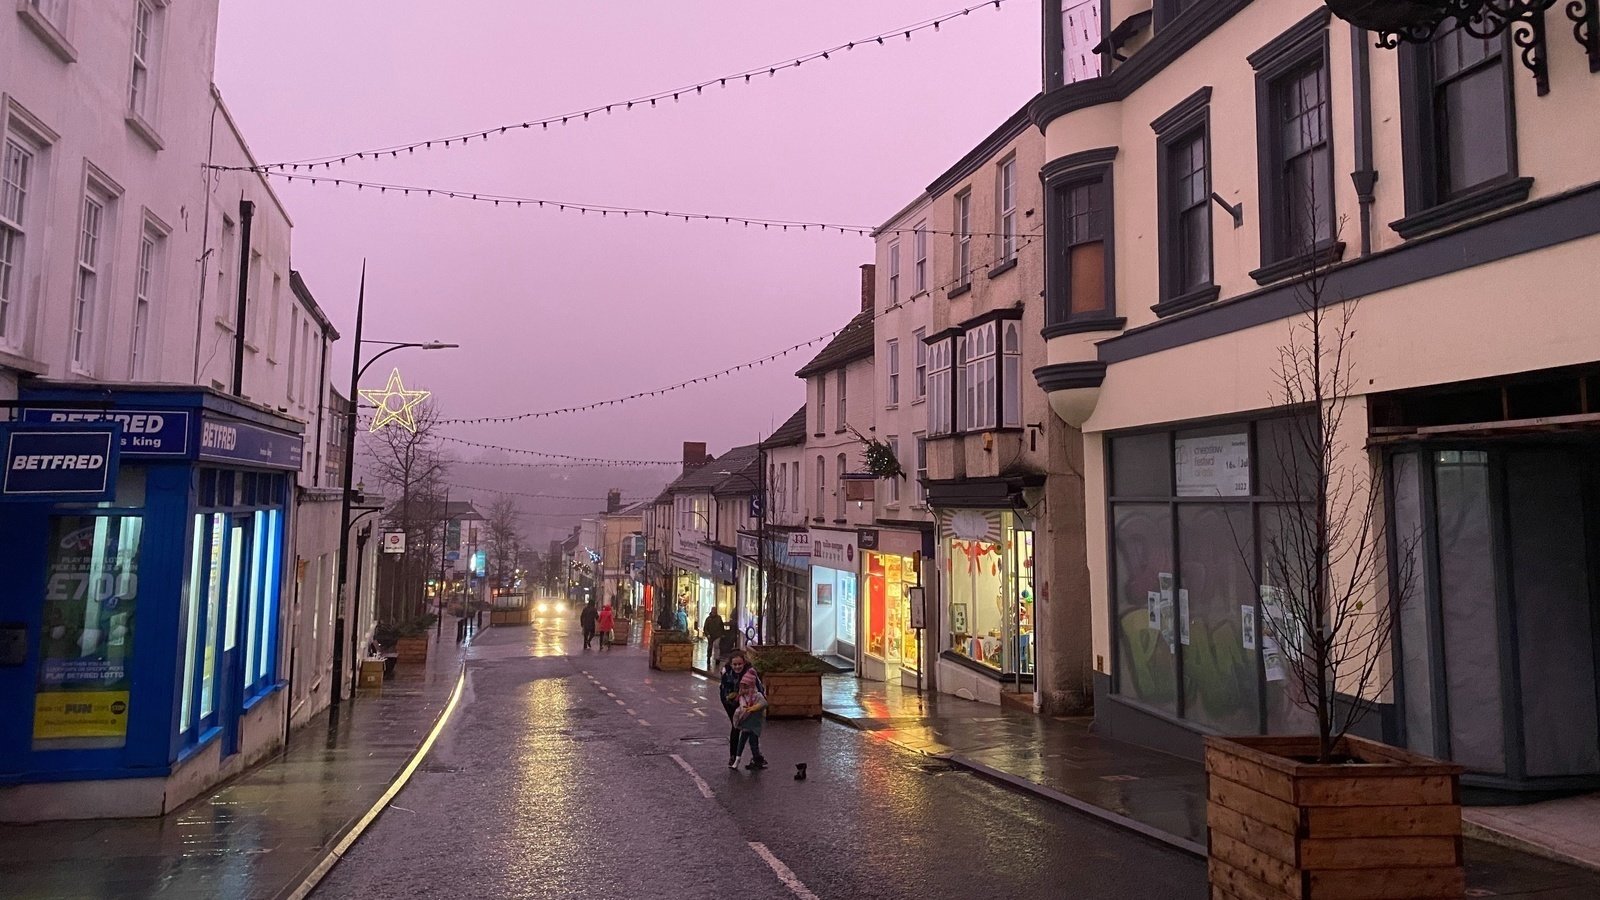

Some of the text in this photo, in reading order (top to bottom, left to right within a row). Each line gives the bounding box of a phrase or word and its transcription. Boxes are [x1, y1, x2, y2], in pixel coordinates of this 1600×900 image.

[133, 436, 162, 448] king
[202, 421, 237, 451] BETFRED
[12, 454, 104, 470] BETFRED
[46, 572, 138, 601] £700
[100, 671, 124, 679] LOTTO
